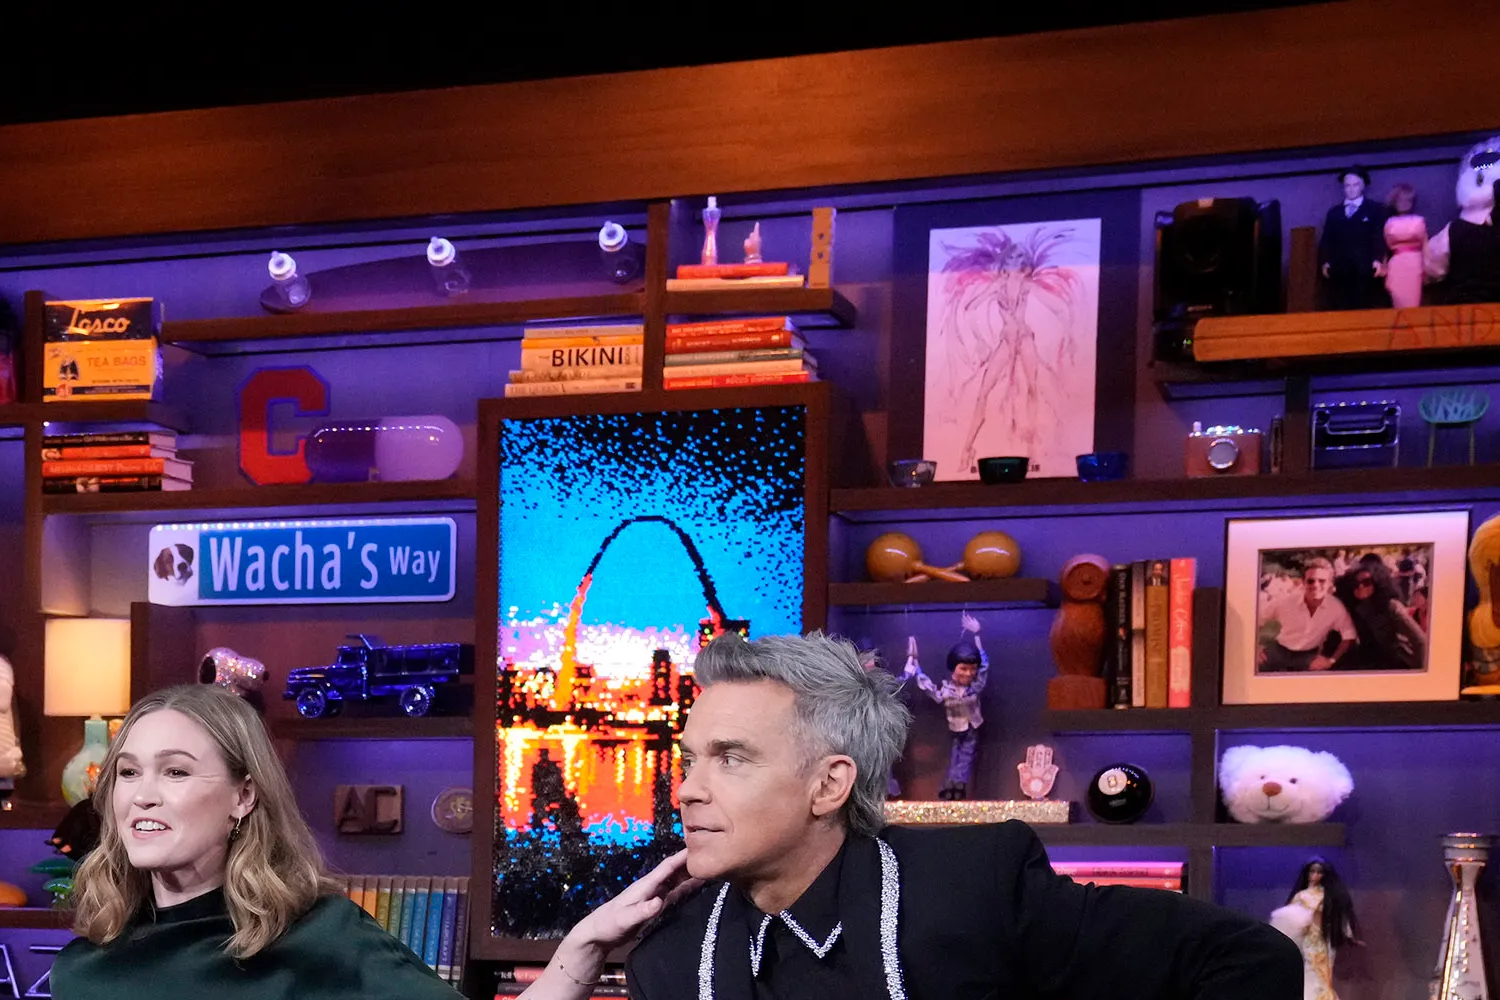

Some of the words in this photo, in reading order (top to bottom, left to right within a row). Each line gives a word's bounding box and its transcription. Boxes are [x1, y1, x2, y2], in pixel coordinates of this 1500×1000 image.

[65, 306, 131, 336] Lasco
[86, 356, 110, 368] TEA
[113, 355, 148, 367] BAGS
[552, 346, 623, 368] BIKINI
[209, 529, 379, 593] Wacha's
[388, 546, 442, 583] Way
